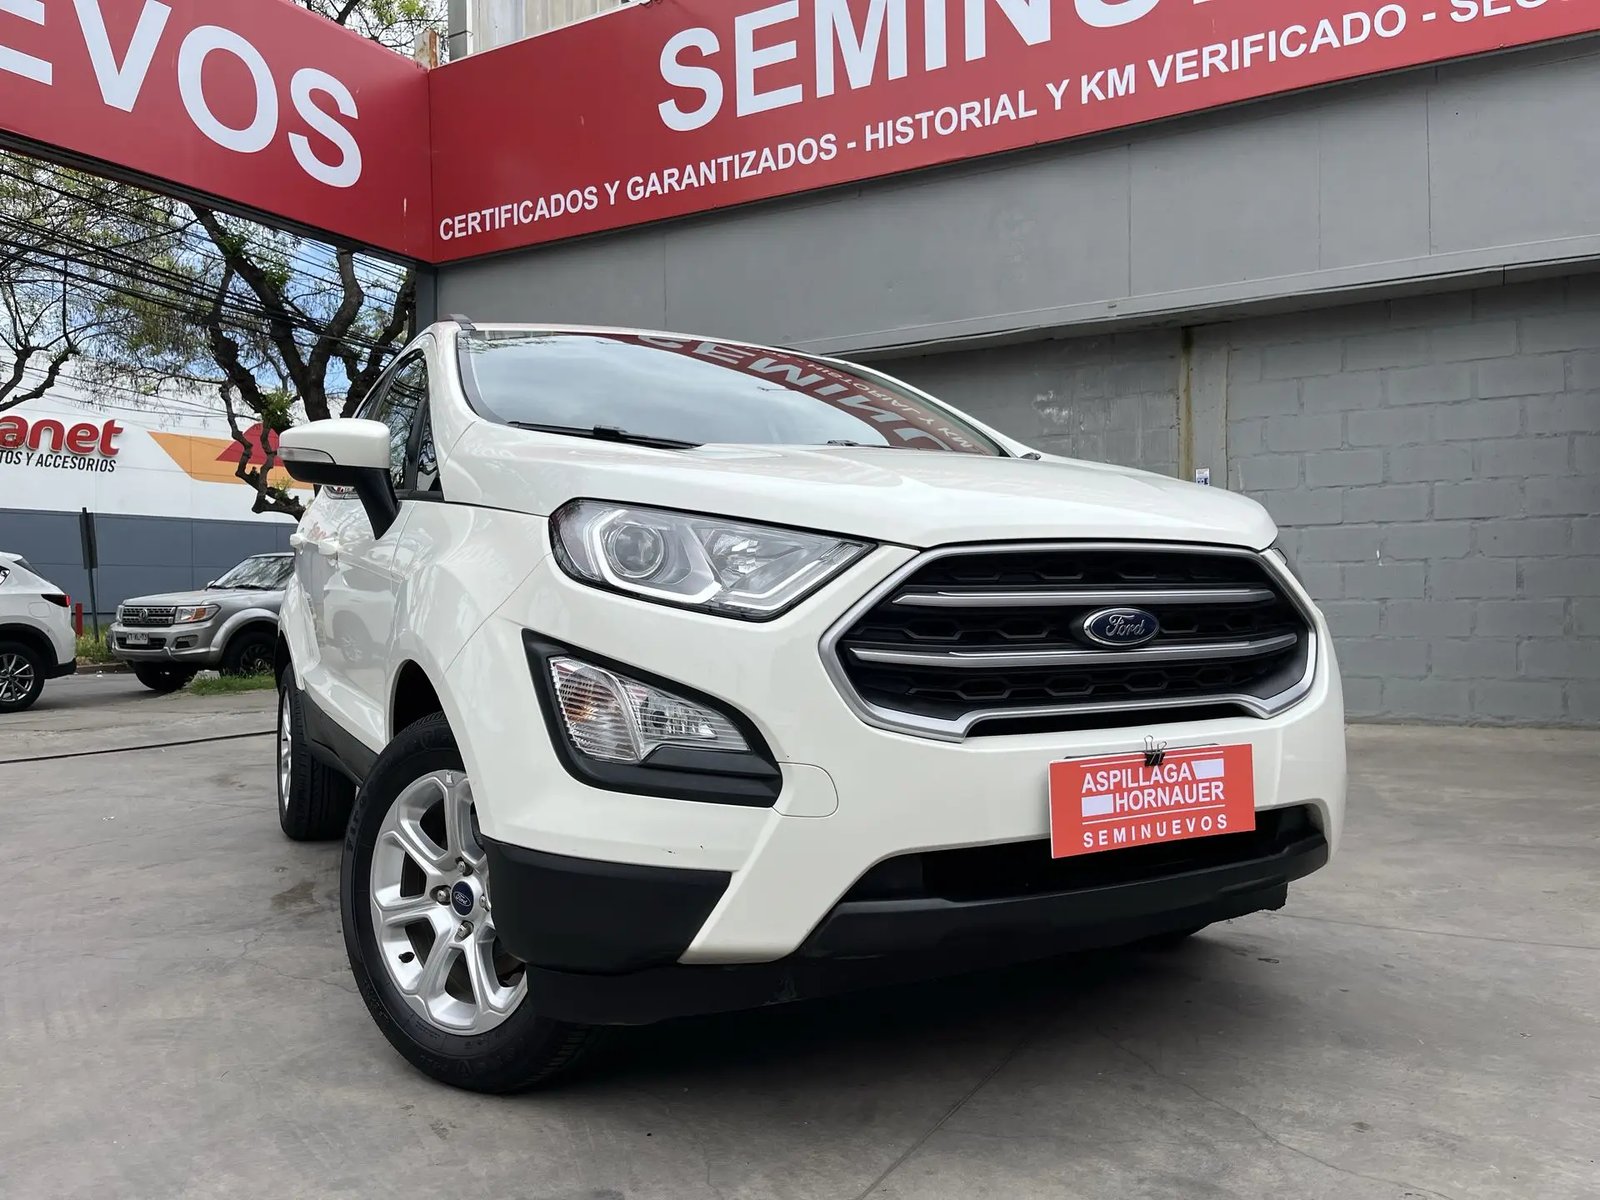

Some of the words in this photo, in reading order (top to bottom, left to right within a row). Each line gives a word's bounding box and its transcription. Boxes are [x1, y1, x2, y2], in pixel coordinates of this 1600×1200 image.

[439, 186, 599, 240] CERTIFICADOS
[604, 180, 620, 206] Y
[626, 133, 837, 201] GARANTIZADOS
[865, 89, 1038, 152] HISTORIAL
[1046, 79, 1070, 110] Y
[1081, 64, 1136, 104] KM
[1147, 4, 1407, 88] VERIFICADO
[26, 452, 34, 466] Y
[35, 454, 117, 473] ACCESORIOS
[1105, 613, 1146, 637] Ford
[1082, 761, 1193, 793] ASPILLAGA
[1116, 781, 1225, 813] HORNAUER
[1083, 814, 1228, 848] SEMINUEVOS
